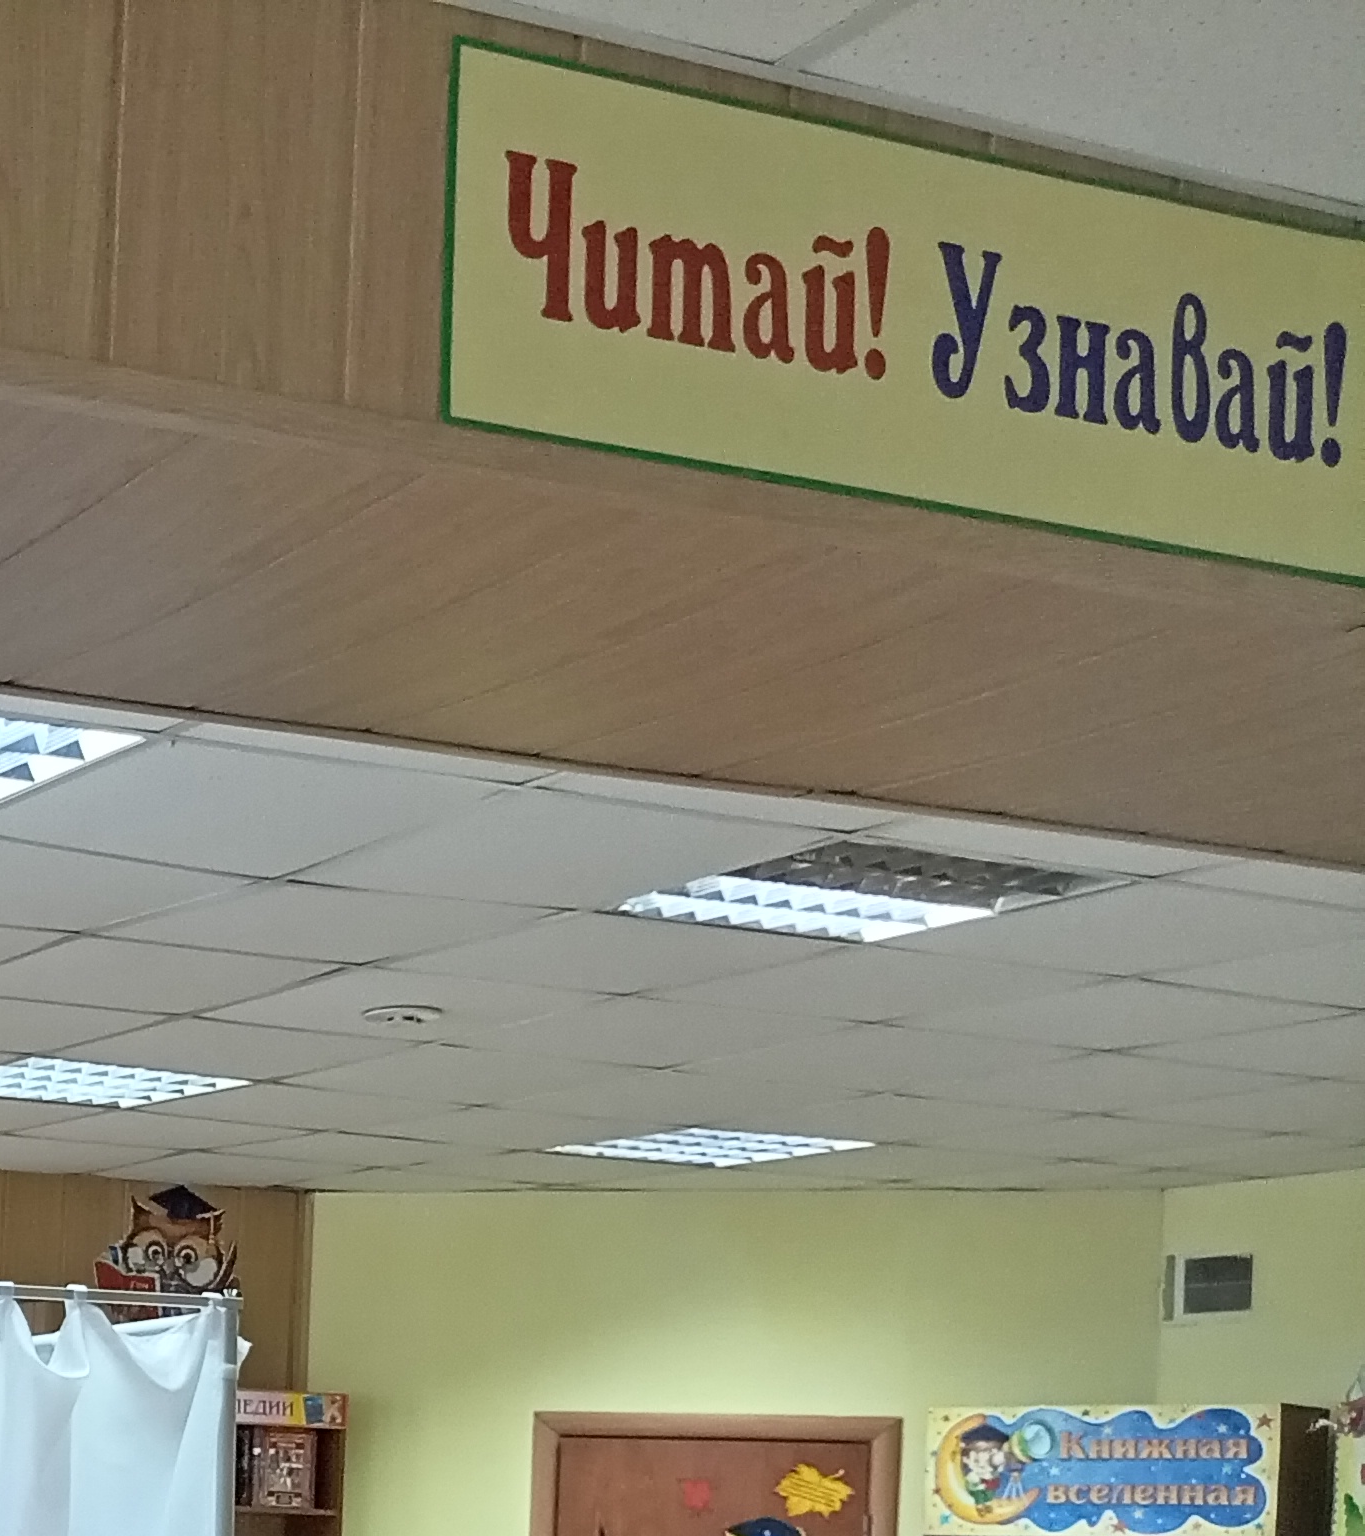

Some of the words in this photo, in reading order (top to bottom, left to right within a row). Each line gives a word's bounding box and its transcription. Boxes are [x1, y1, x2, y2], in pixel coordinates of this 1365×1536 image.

[504, 150, 890, 381] Читай!
[932, 241, 1348, 468] Узнавай!
[1060, 1431, 1249, 1460] Книжная
[1046, 1483, 1256, 1506] вселенная
